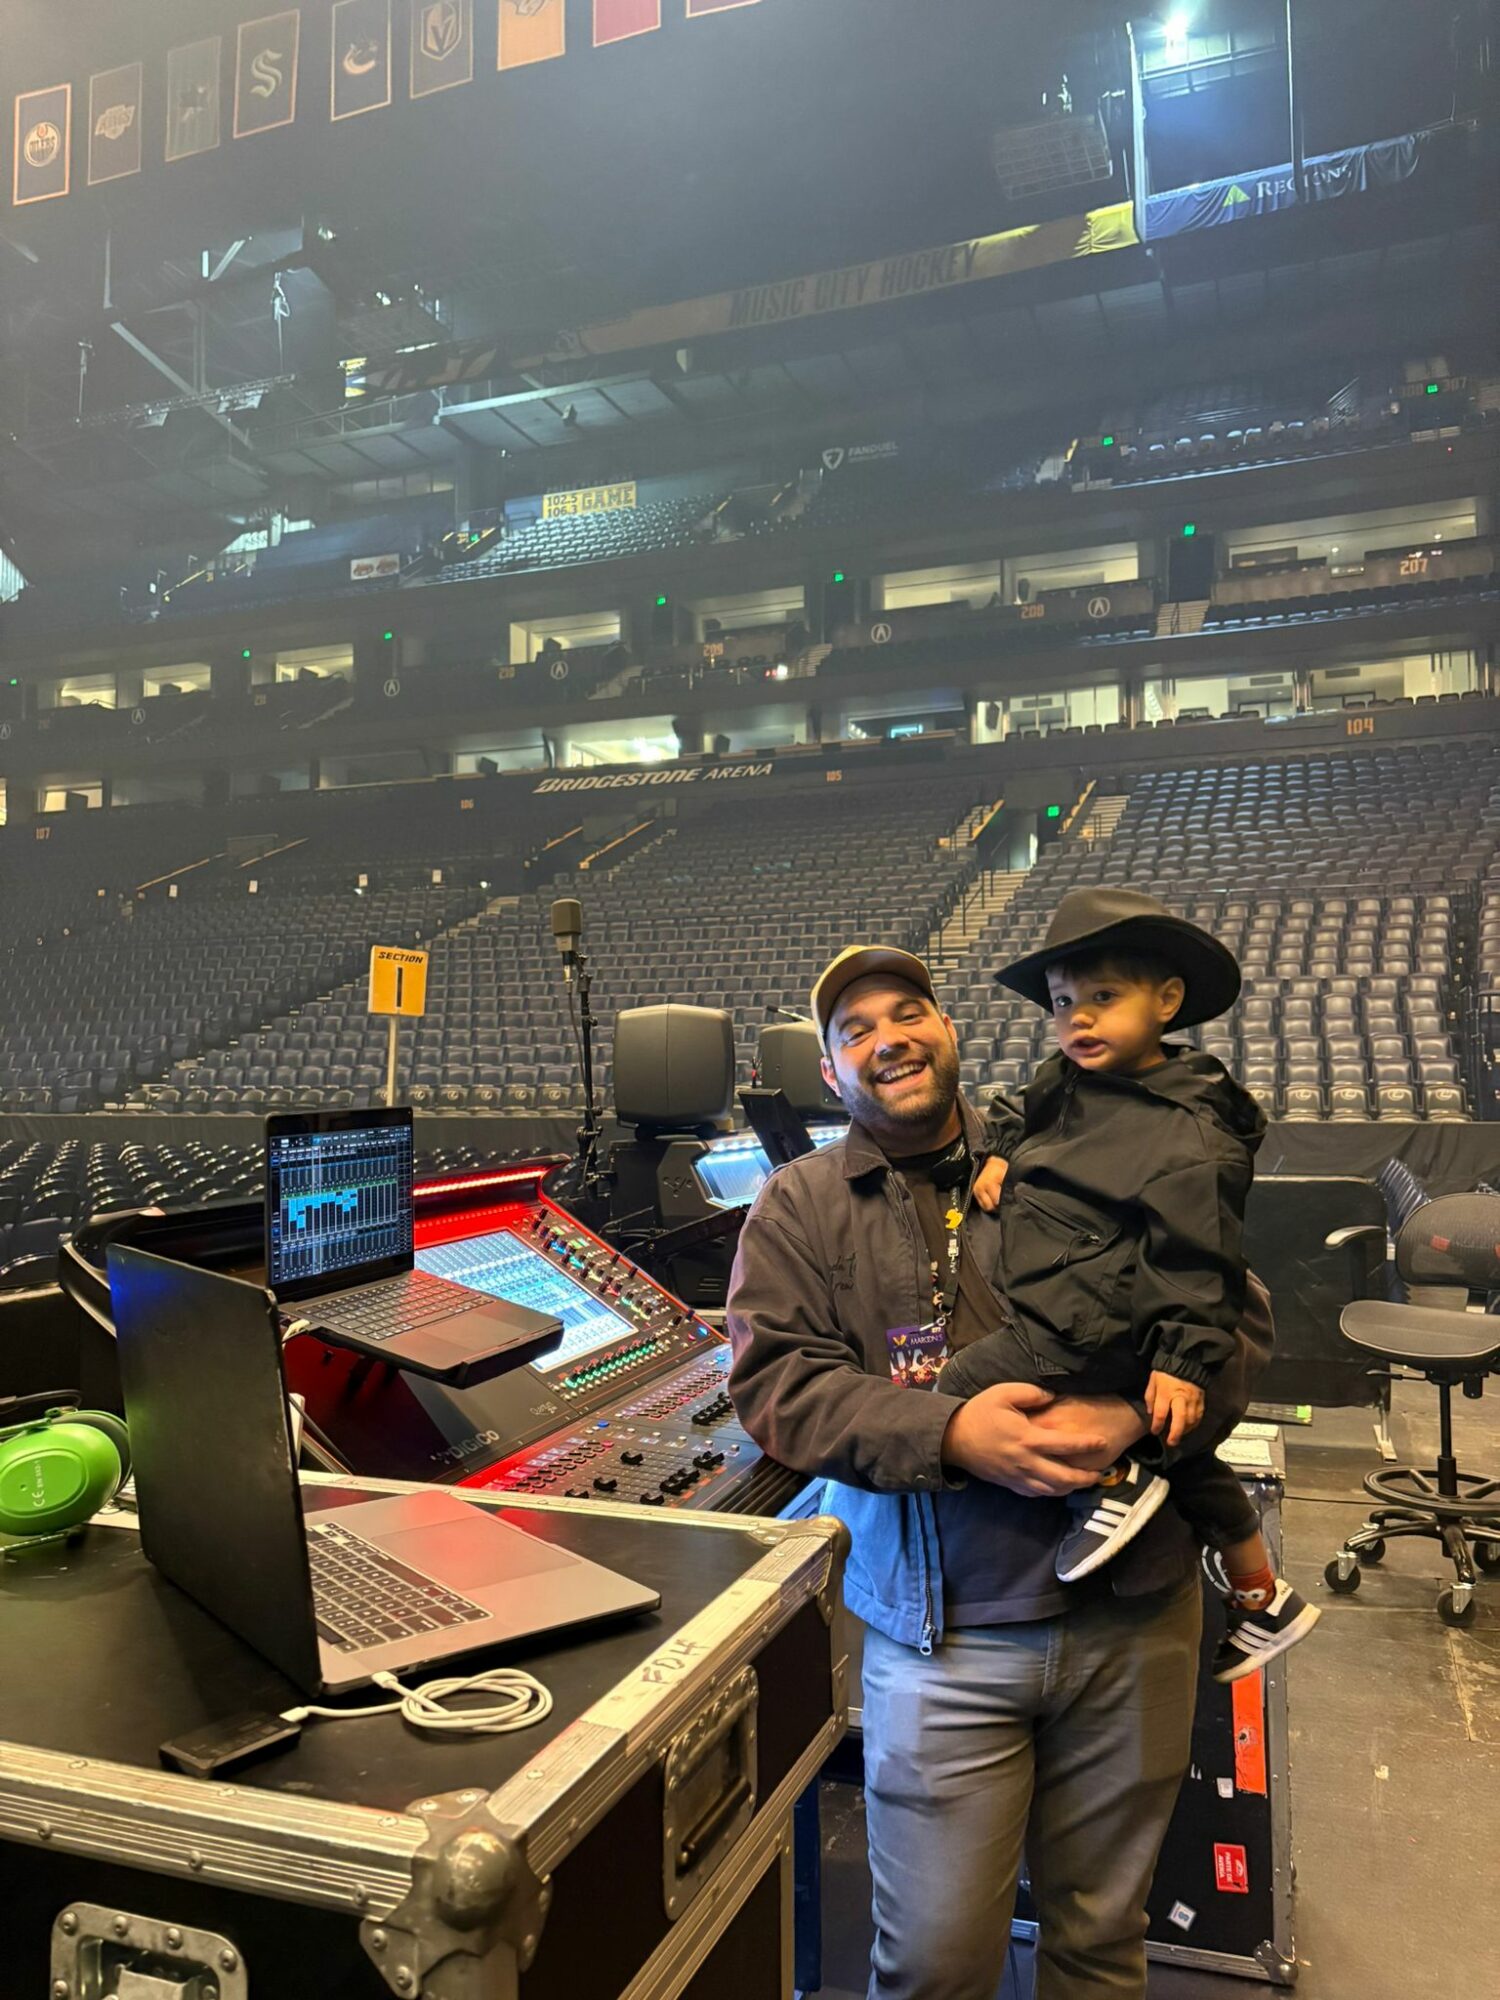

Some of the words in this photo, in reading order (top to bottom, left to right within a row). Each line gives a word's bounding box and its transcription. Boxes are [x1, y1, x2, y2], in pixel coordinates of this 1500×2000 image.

[728, 278, 806, 326] MUSIC
[814, 266, 872, 310] CITY
[880, 242, 979, 298] HOCKEY
[848, 441, 899, 457] FANDUEL
[582, 486, 634, 509] GAME
[1400, 557, 1428, 576] 207
[1346, 717, 1375, 736] 104
[532, 767, 702, 794] BRIDGESTONE
[702, 763, 774, 781] ARENA
[377, 951, 424, 964] SECTION
